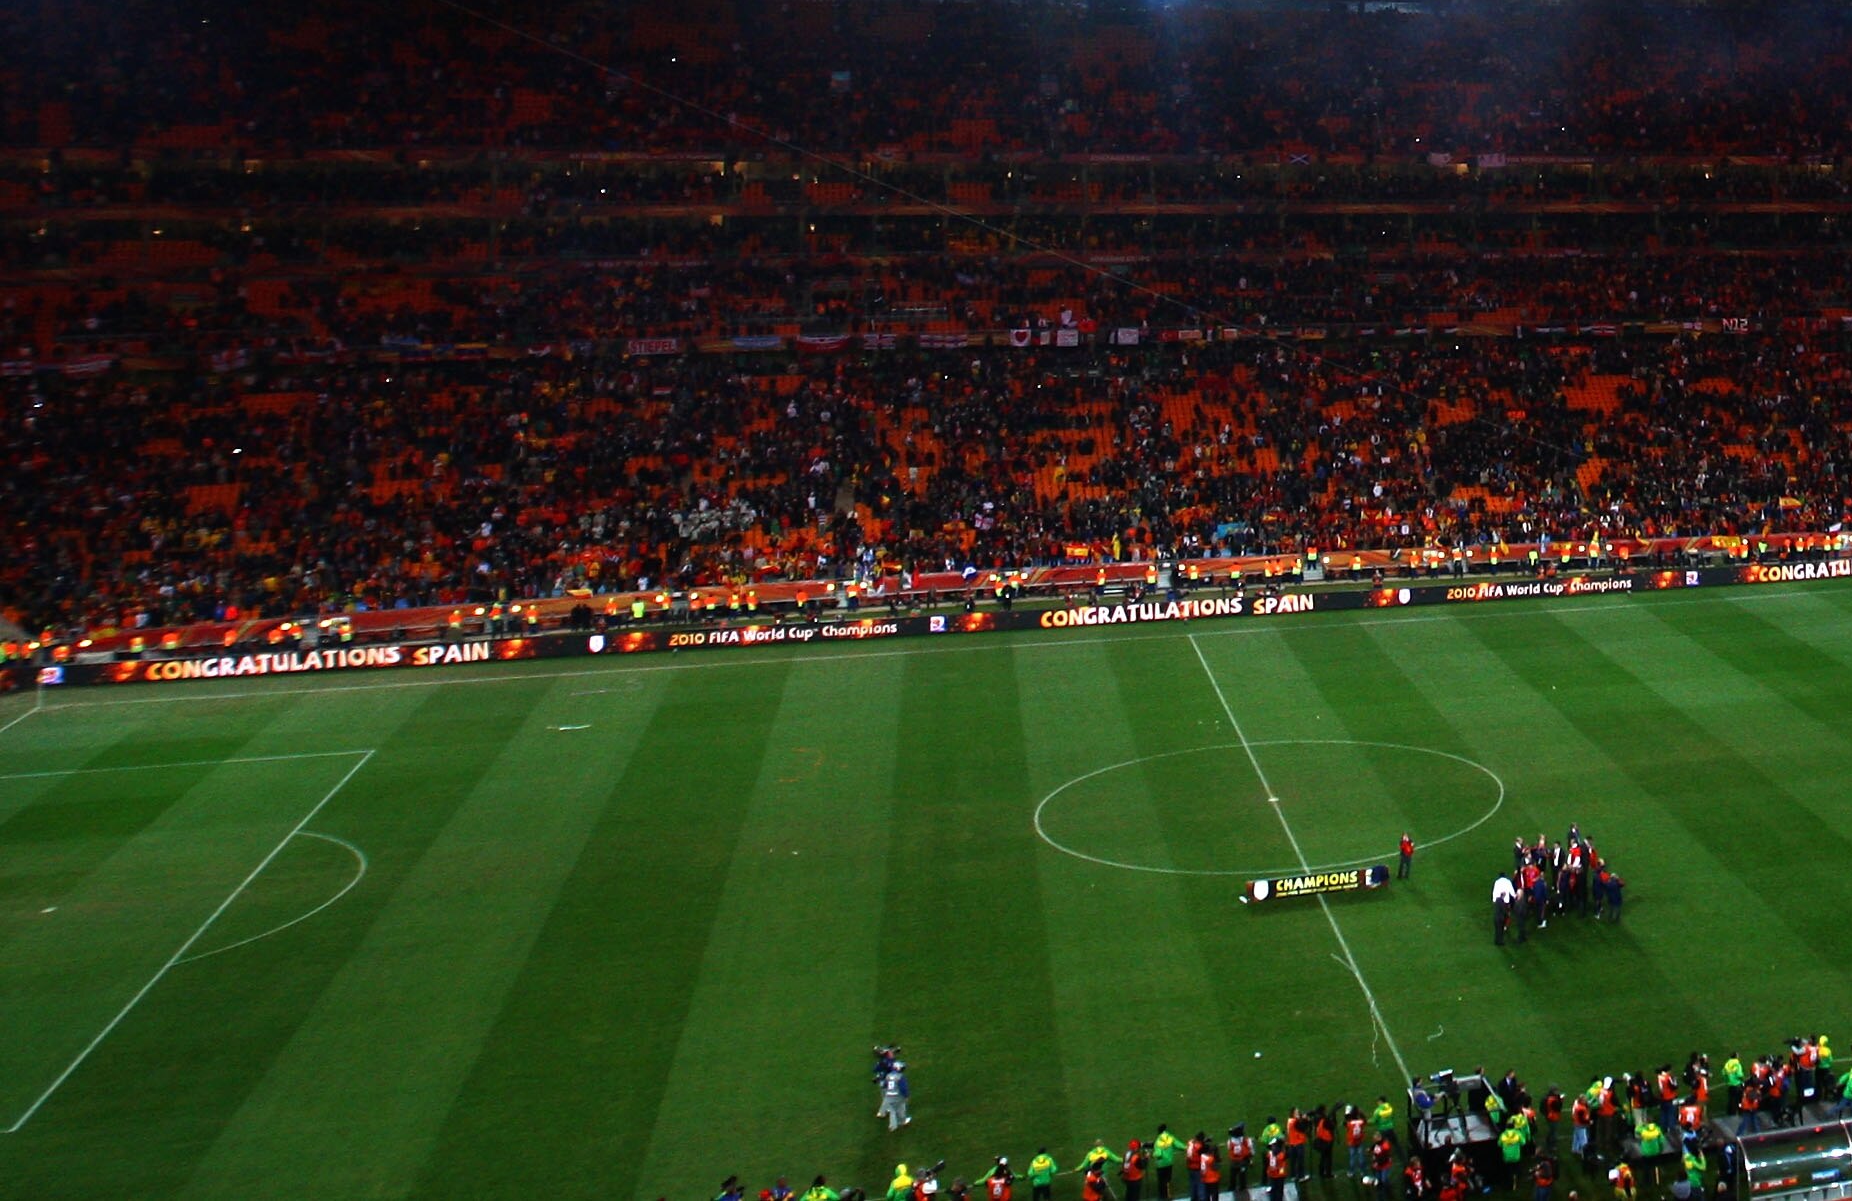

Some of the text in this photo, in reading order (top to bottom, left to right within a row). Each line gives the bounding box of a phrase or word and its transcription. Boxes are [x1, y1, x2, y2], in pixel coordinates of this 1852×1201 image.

[1446, 586, 1476, 600] 2010
[1477, 585, 1503, 598] FIFA
[1506, 581, 1541, 596] World
[1569, 577, 1632, 594] Champions
[1040, 593, 1315, 629] CONGRATULATIONS SPAIN
[668, 631, 706, 647] 2010
[709, 630, 740, 645] FIFA
[743, 625, 786, 643] World
[821, 620, 898, 641] Champions
[144, 641, 490, 681] CONGRATULATIONS SPAIN
[1276, 871, 1358, 891] CHAMPIONS
